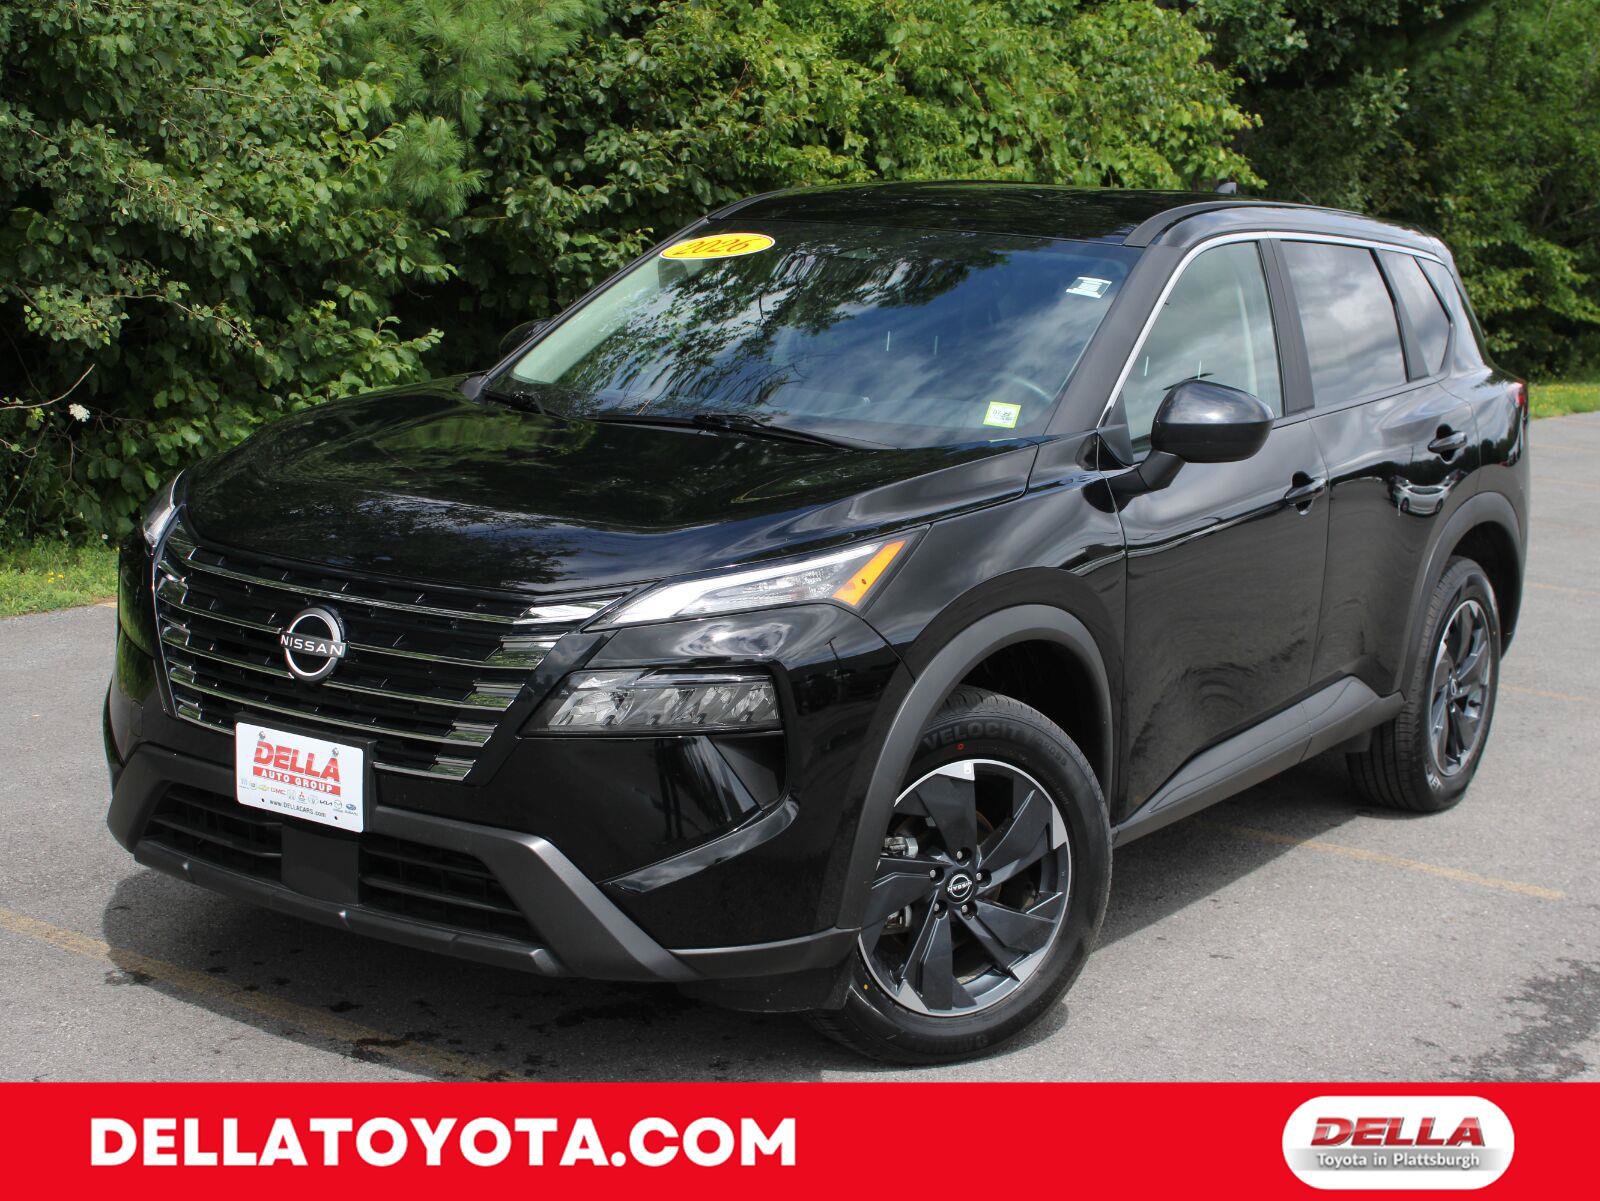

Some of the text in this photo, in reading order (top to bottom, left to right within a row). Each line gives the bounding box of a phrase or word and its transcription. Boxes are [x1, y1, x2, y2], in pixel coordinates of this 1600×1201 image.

[671, 238, 762, 256] 2026
[280, 634, 343, 656] NISSAN
[253, 740, 341, 783] DELLA
[261, 768, 334, 794] AUTO GROUP
